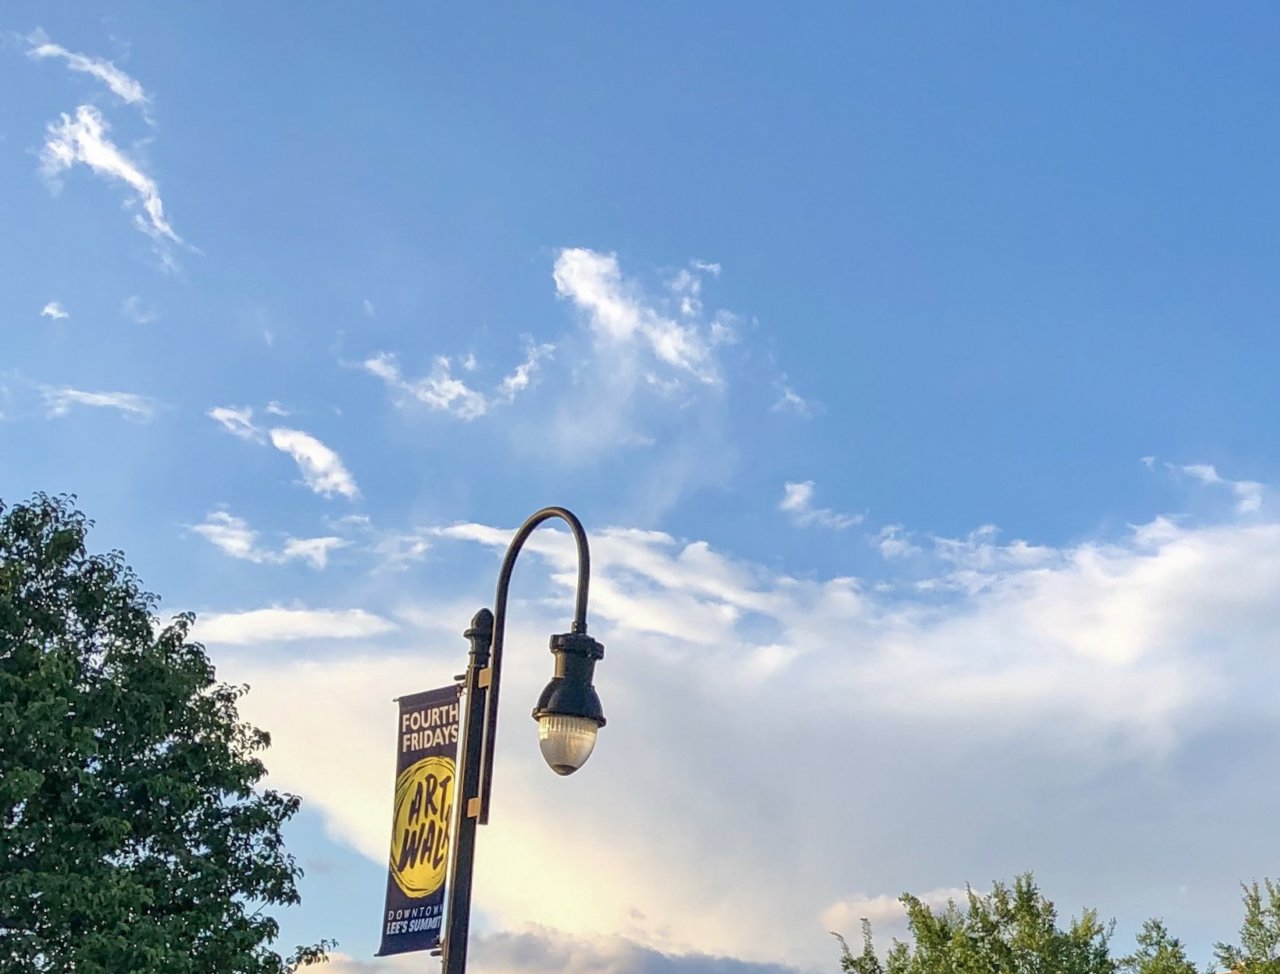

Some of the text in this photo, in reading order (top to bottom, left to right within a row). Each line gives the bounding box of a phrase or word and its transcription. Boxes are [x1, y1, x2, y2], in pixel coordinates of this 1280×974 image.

[402, 703, 459, 732] FOURTH
[402, 724, 459, 753] FRIDAYS
[408, 773, 452, 826] ART
[386, 916, 441, 935] LEE'S SUMMIT
